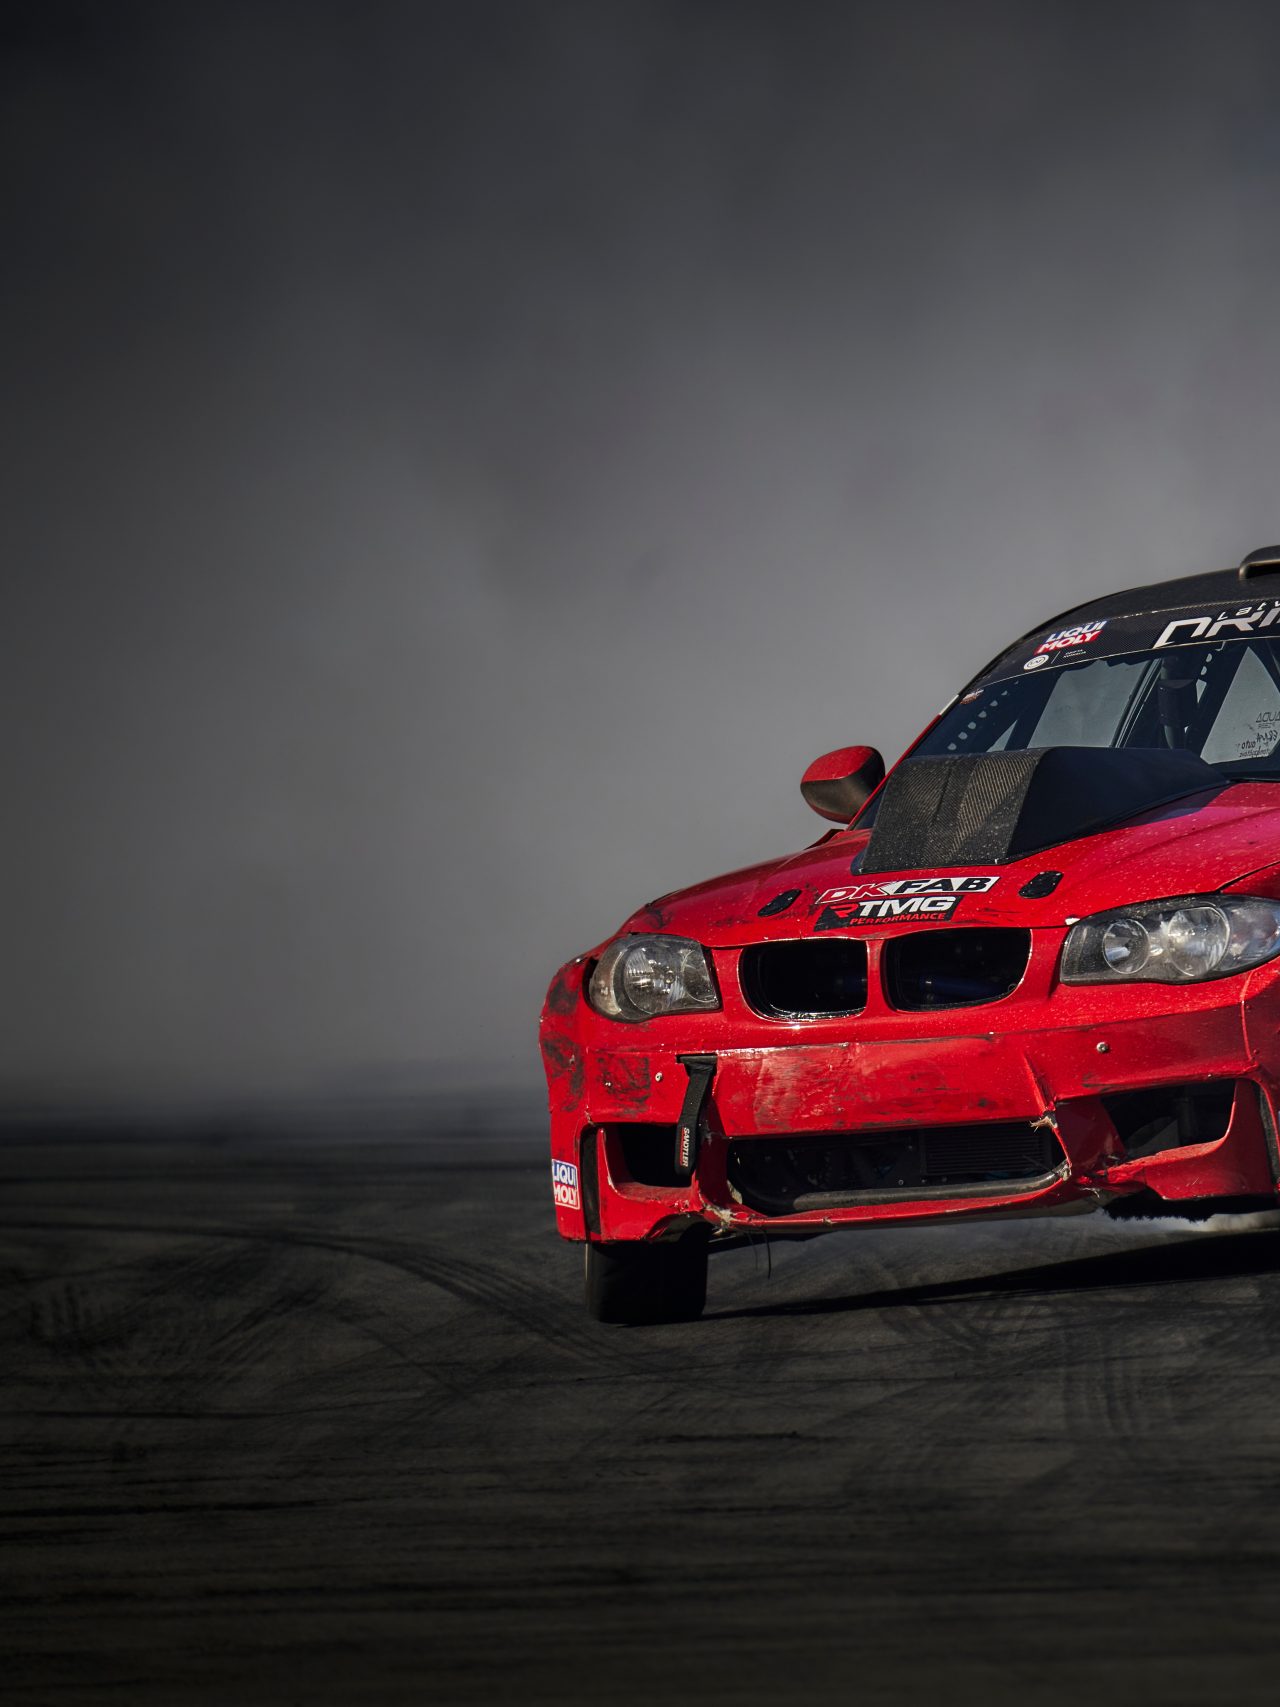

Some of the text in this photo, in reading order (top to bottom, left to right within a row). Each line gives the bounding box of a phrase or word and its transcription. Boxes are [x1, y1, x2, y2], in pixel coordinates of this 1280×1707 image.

[1035, 630, 1102, 654] MOLY
[1045, 620, 1108, 643] LIQUI
[850, 912, 946, 925] PERFORMANCE
[682, 1127, 690, 1168] SANDTLER
[553, 1183, 577, 1207] MOLY
